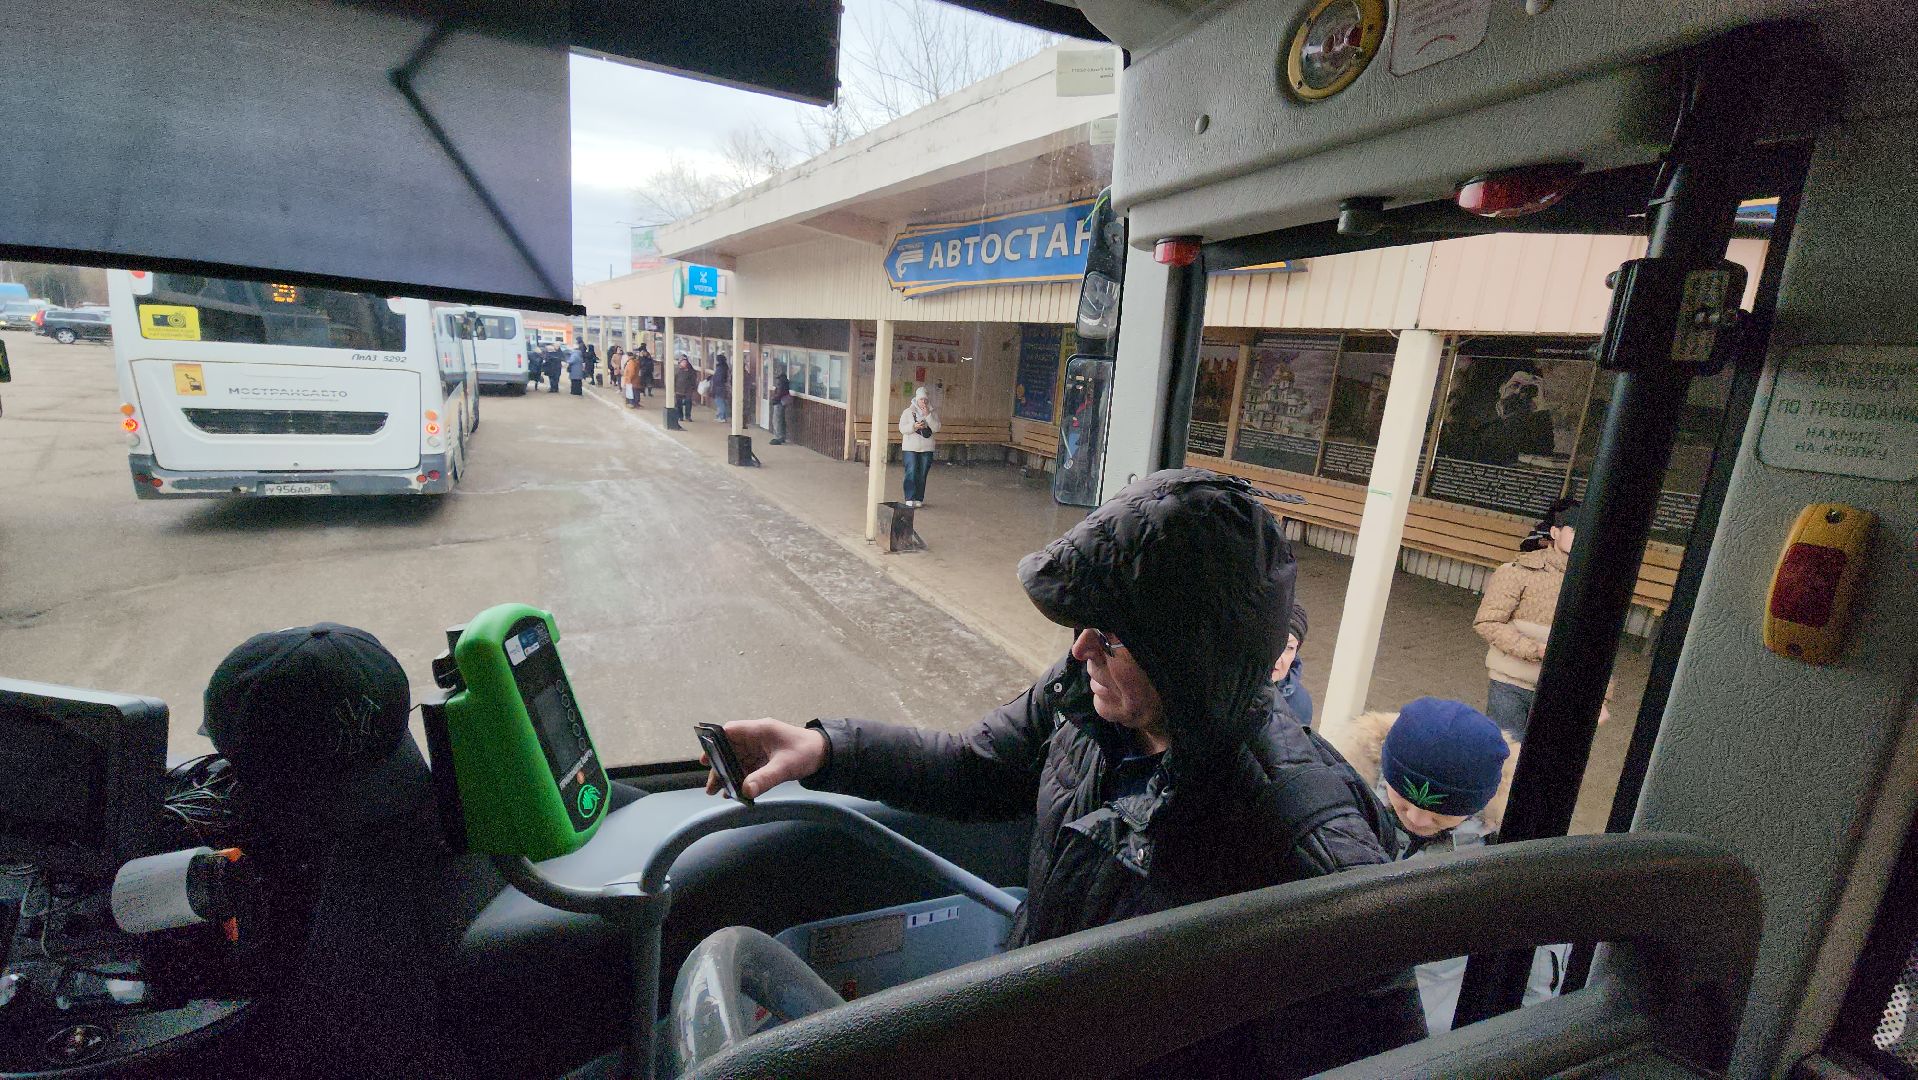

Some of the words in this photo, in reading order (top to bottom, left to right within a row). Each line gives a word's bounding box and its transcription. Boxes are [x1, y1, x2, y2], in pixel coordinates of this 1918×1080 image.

[383, 355, 407, 363] 5292
[228, 387, 348, 398] МОСТРАНСАВТО
[1777, 398, 1801, 415] ПО
[1805, 427, 1884, 445] НАЖМИТЕ
[1793, 442, 1815, 454] НА
[1820, 444, 1888, 461] КНОПКУ
